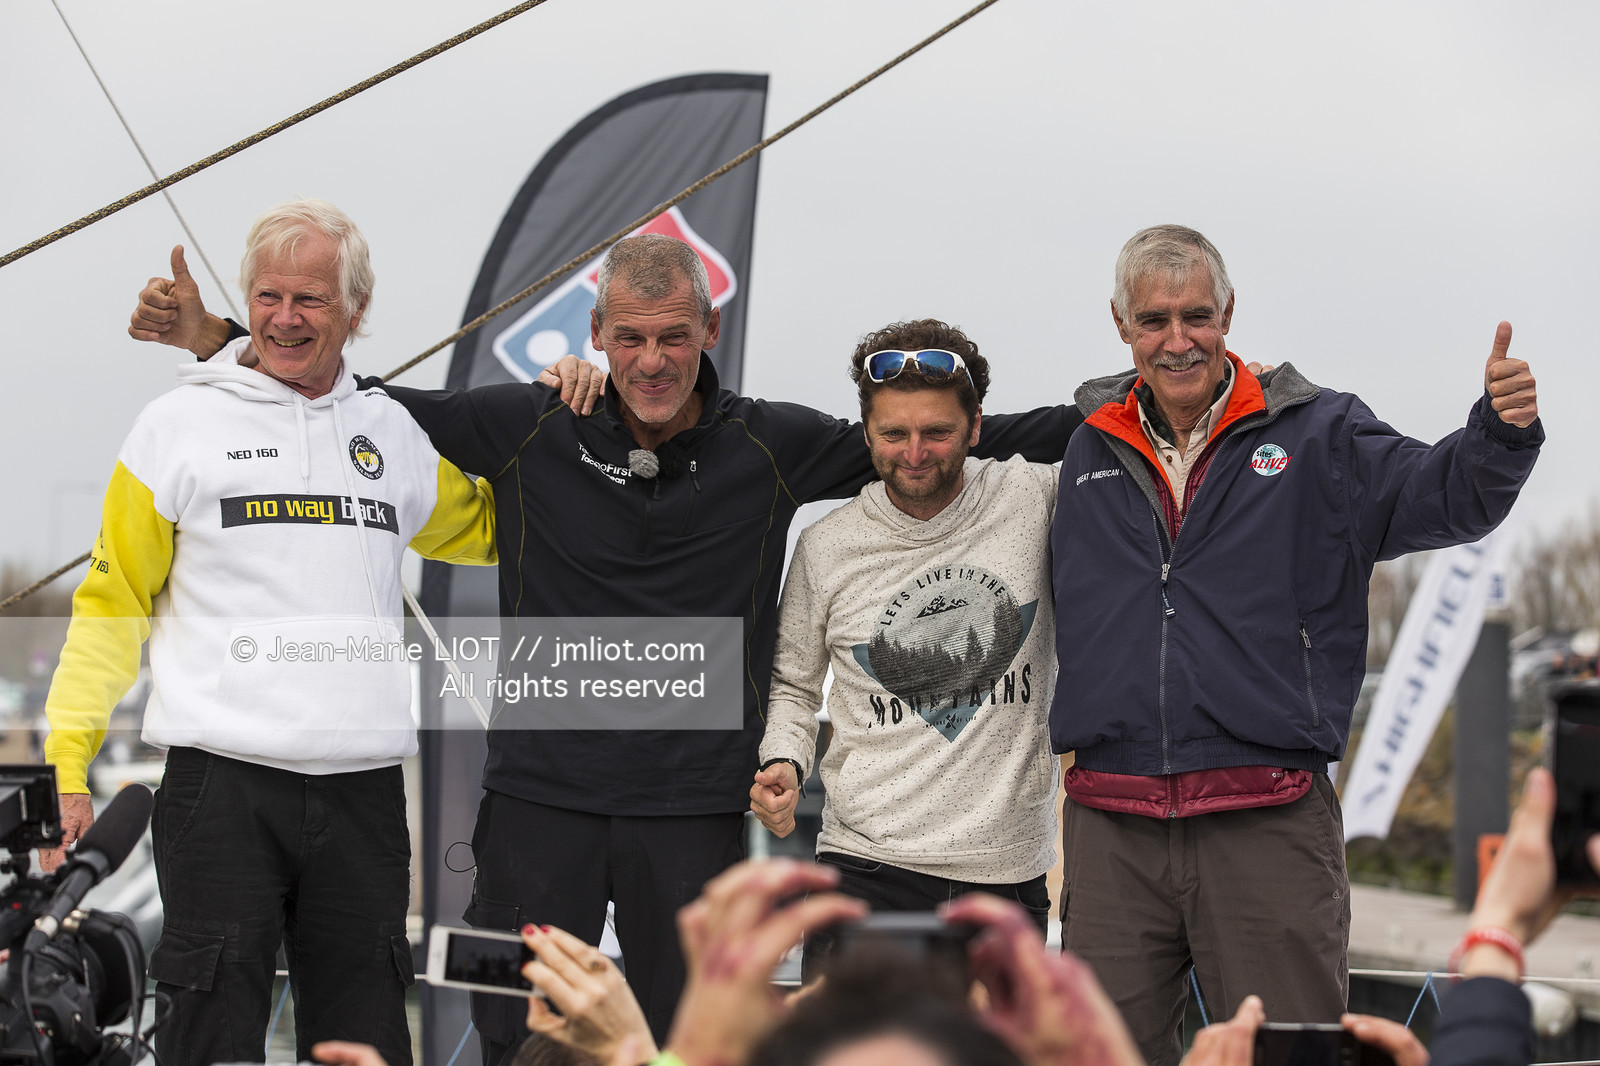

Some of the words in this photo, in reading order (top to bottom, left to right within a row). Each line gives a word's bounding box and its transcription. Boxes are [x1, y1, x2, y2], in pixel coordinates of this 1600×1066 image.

[227, 450, 252, 460] NED
[256, 449, 278, 458] 160
[1256, 449, 1272, 458] sites
[1249, 455, 1292, 470] ALIVE!
[1090, 469, 1120, 479] AMERICAN
[246, 500, 278, 518] no
[285, 500, 334, 524] way
[881, 591, 911, 626] LETS
[916, 569, 951, 589] LIVE
[959, 568, 975, 580] IN
[980, 573, 1006, 597] THE
